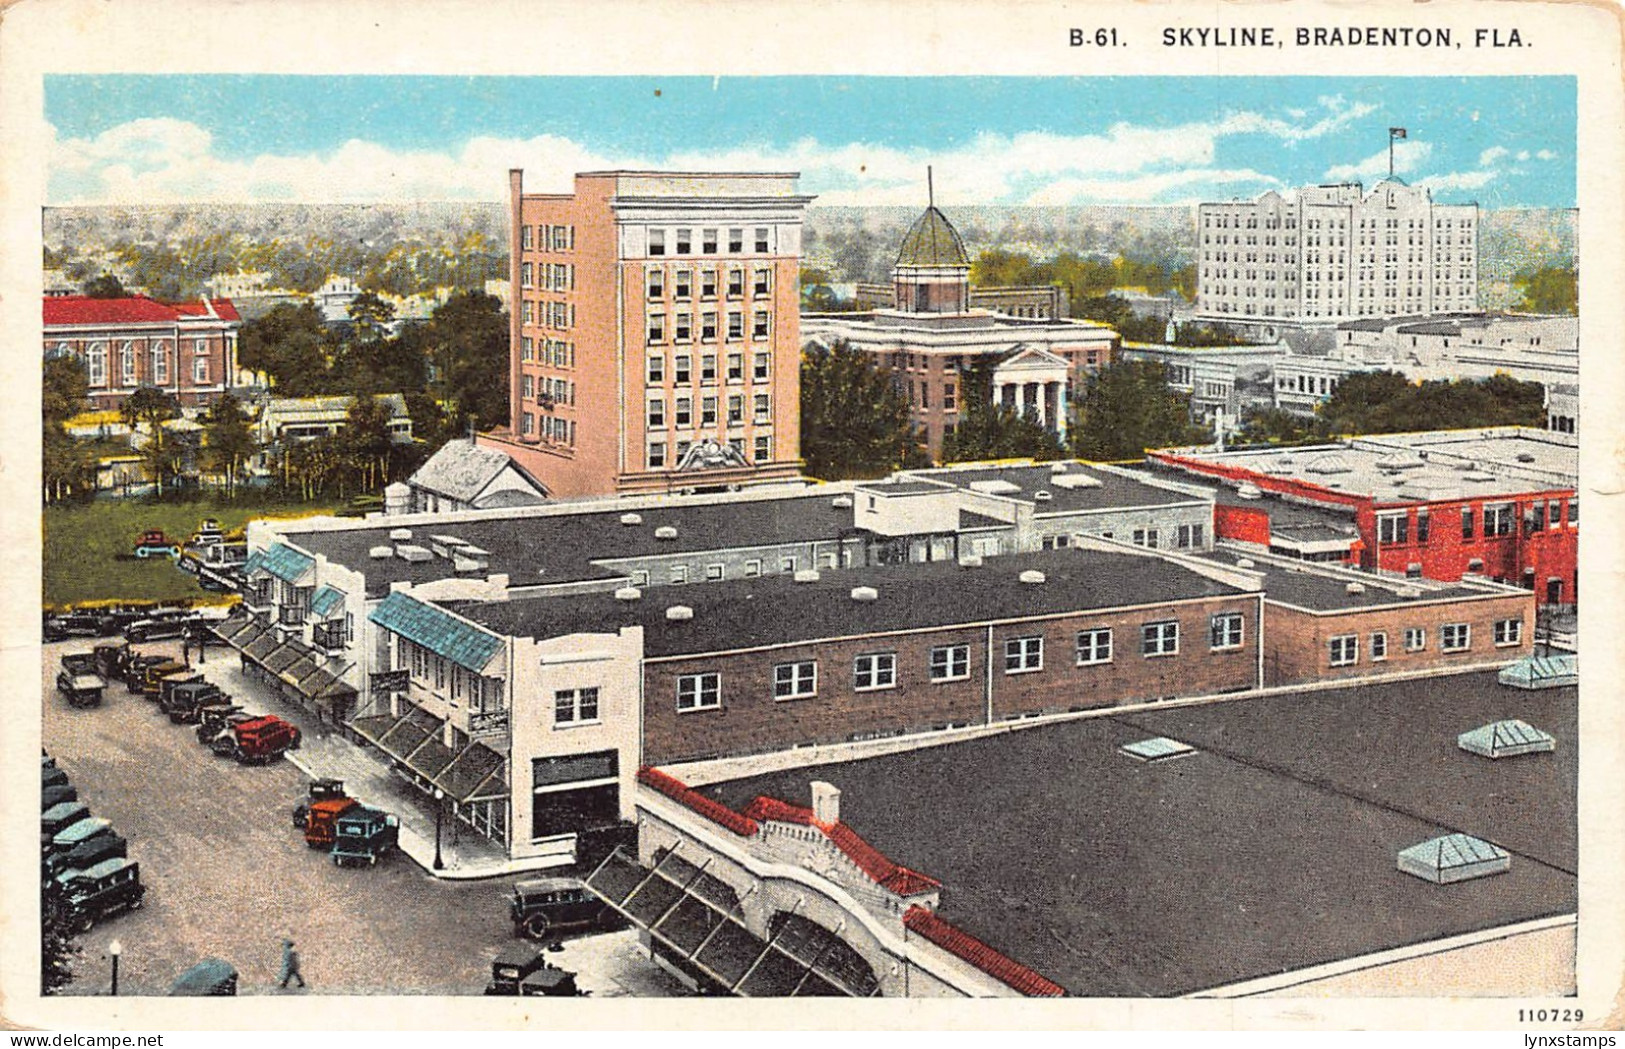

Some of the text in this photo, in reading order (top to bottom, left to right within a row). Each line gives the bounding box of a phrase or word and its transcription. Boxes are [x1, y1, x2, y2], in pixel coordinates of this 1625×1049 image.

[1070, 28, 1532, 48] B-61. SKYLINE, BRADENTON, FLA.
[1518, 1009, 1584, 1022] 110729
